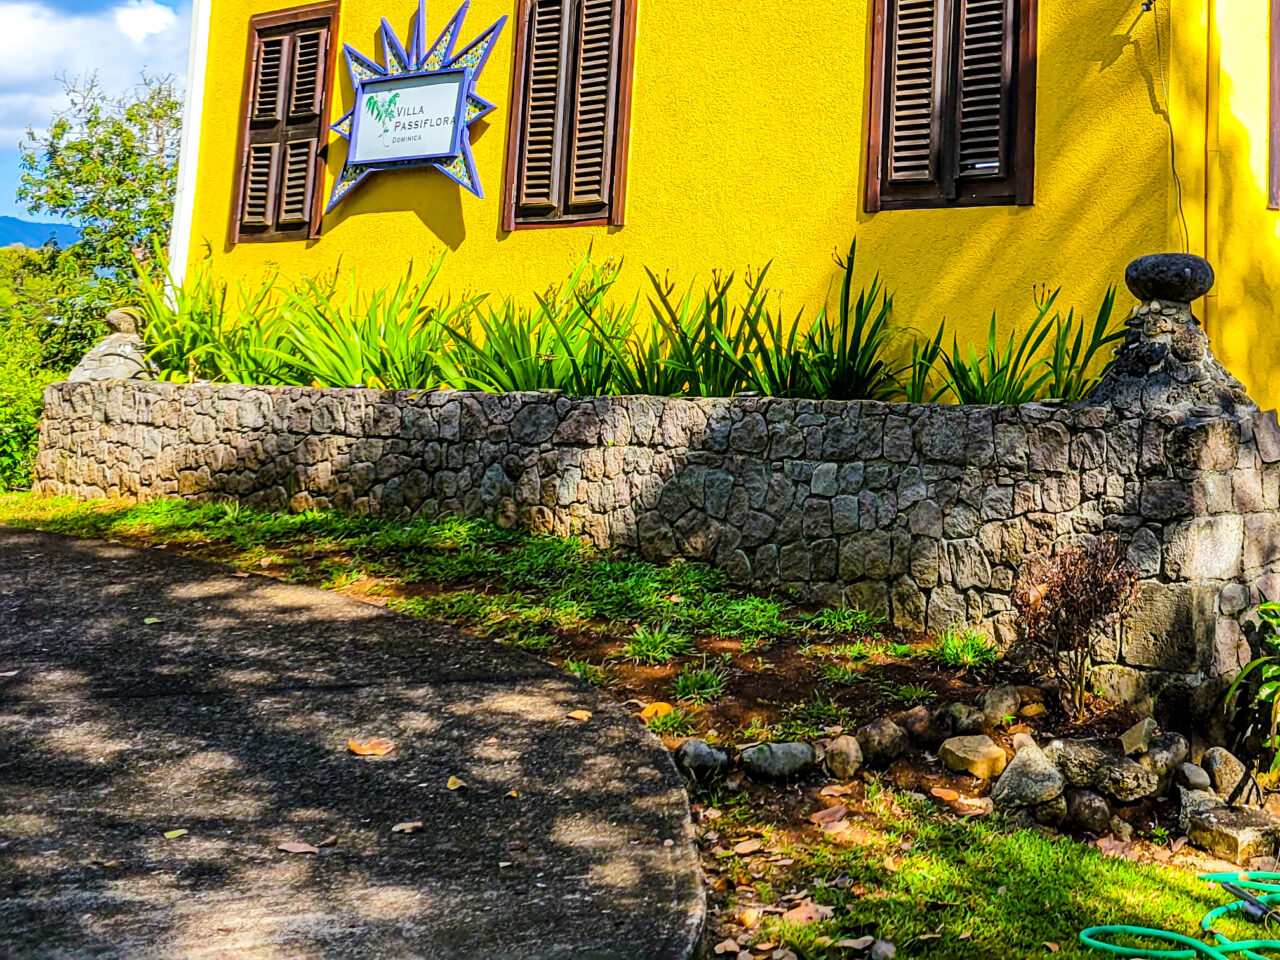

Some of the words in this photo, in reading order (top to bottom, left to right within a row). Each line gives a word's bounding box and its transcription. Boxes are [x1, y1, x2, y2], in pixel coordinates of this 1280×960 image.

[396, 105, 425, 117] VILLA
[394, 116, 456, 132] PASSIFLORA
[392, 134, 422, 144] DOMINICA
